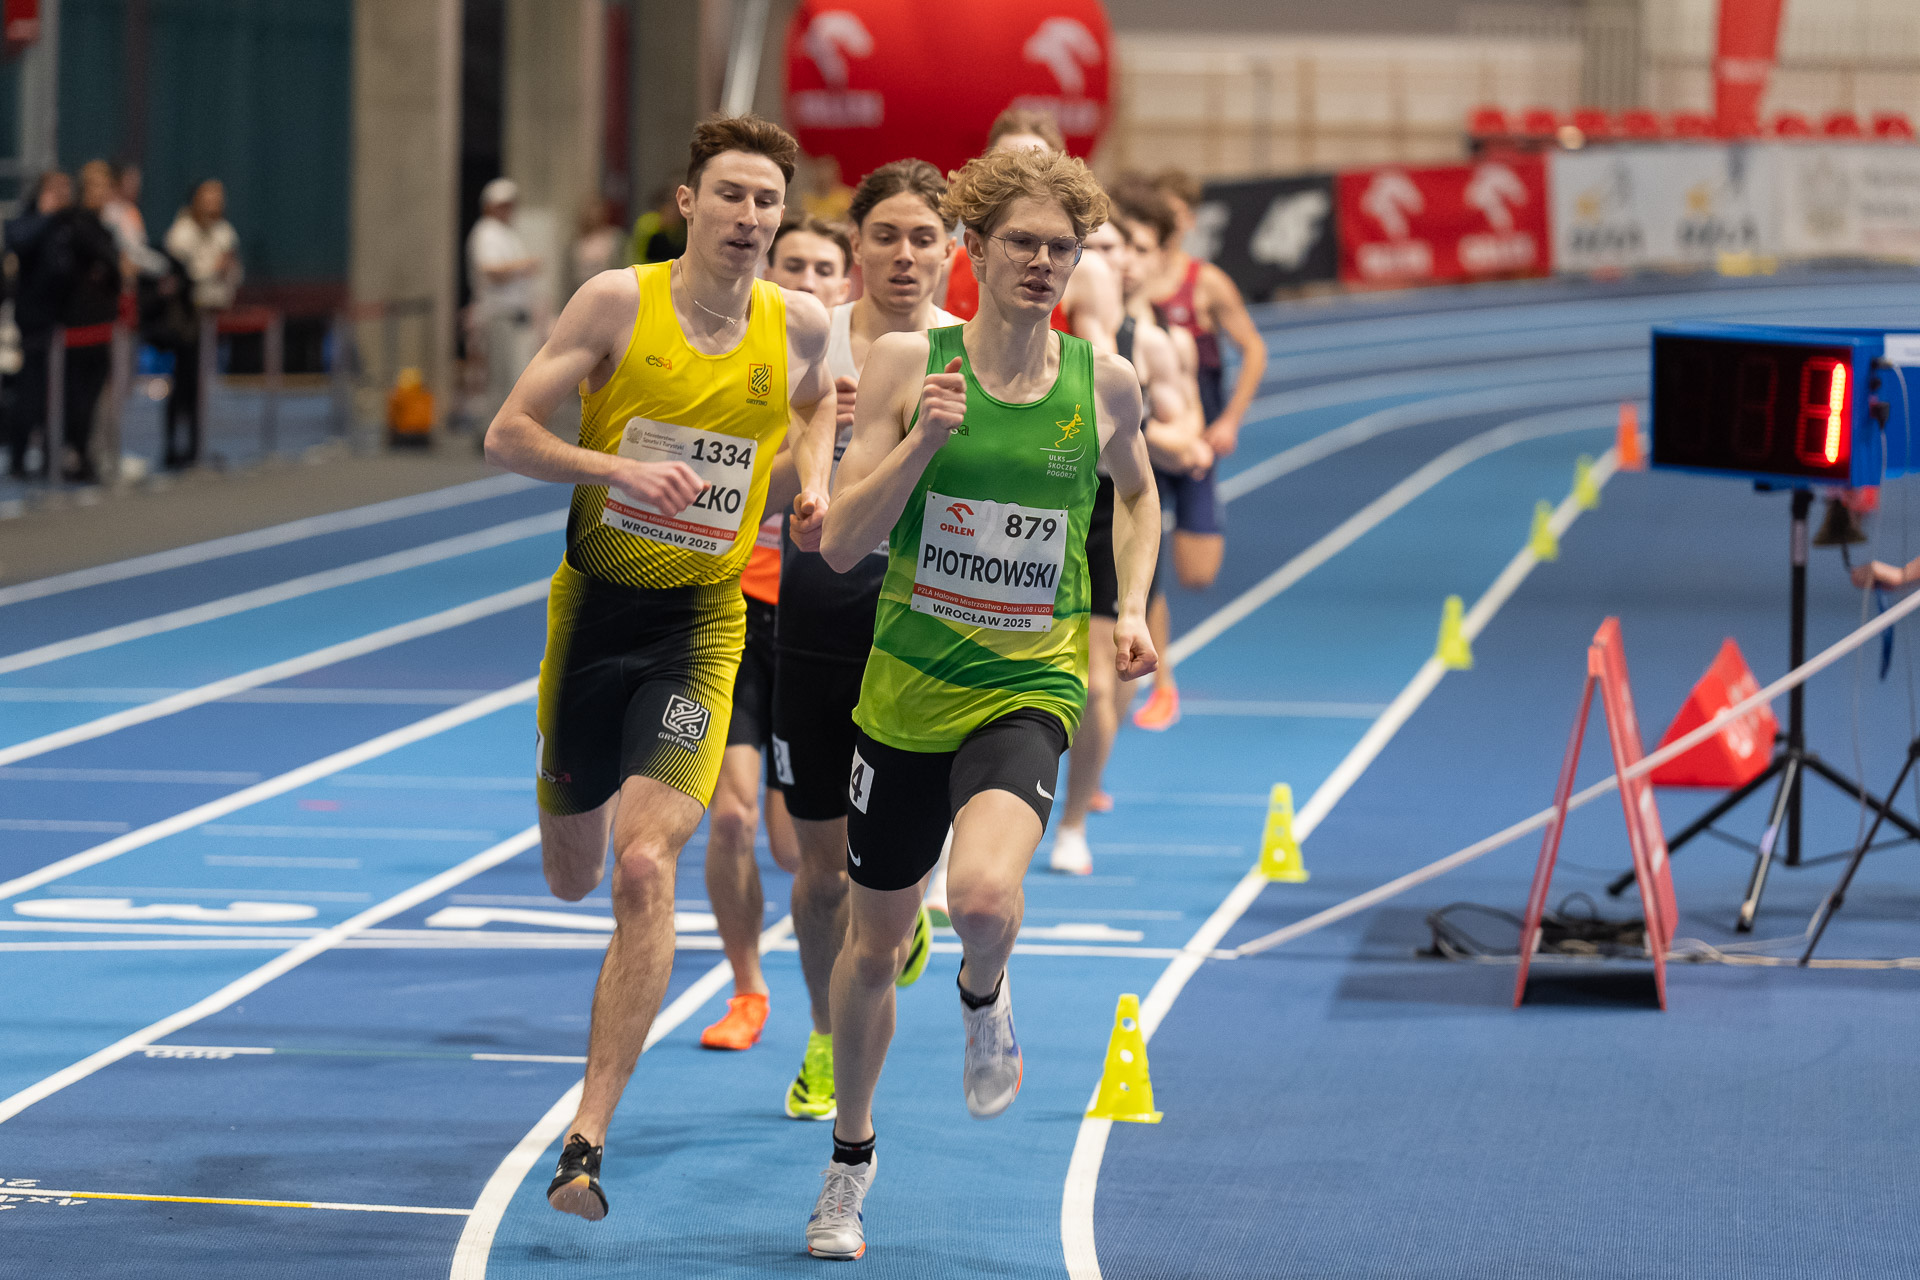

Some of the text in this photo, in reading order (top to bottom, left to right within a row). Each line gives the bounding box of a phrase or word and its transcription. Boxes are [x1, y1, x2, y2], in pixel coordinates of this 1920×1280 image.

[691, 438, 752, 469] 1334
[1049, 454, 1066, 462] ULKS
[1048, 462, 1077, 472] SKOCZEK
[621, 518, 717, 551] WROCŁAW 2025
[649, 515, 688, 530] Mistrzostwa
[689, 524, 709, 534] Polski
[940, 523, 975, 537] ORLEN
[1005, 514, 1057, 541] 879
[923, 543, 1057, 588] PIOTROWSKI
[917, 586, 933, 596] PZLA
[934, 591, 959, 603] Halowe
[960, 598, 1001, 611] Mistrzostwa
[1002, 605, 1022, 613] Polski
[932, 603, 1031, 628] WROCŁAW 2025
[657, 731, 697, 752] GRYFINO
[852, 763, 864, 803] 4
